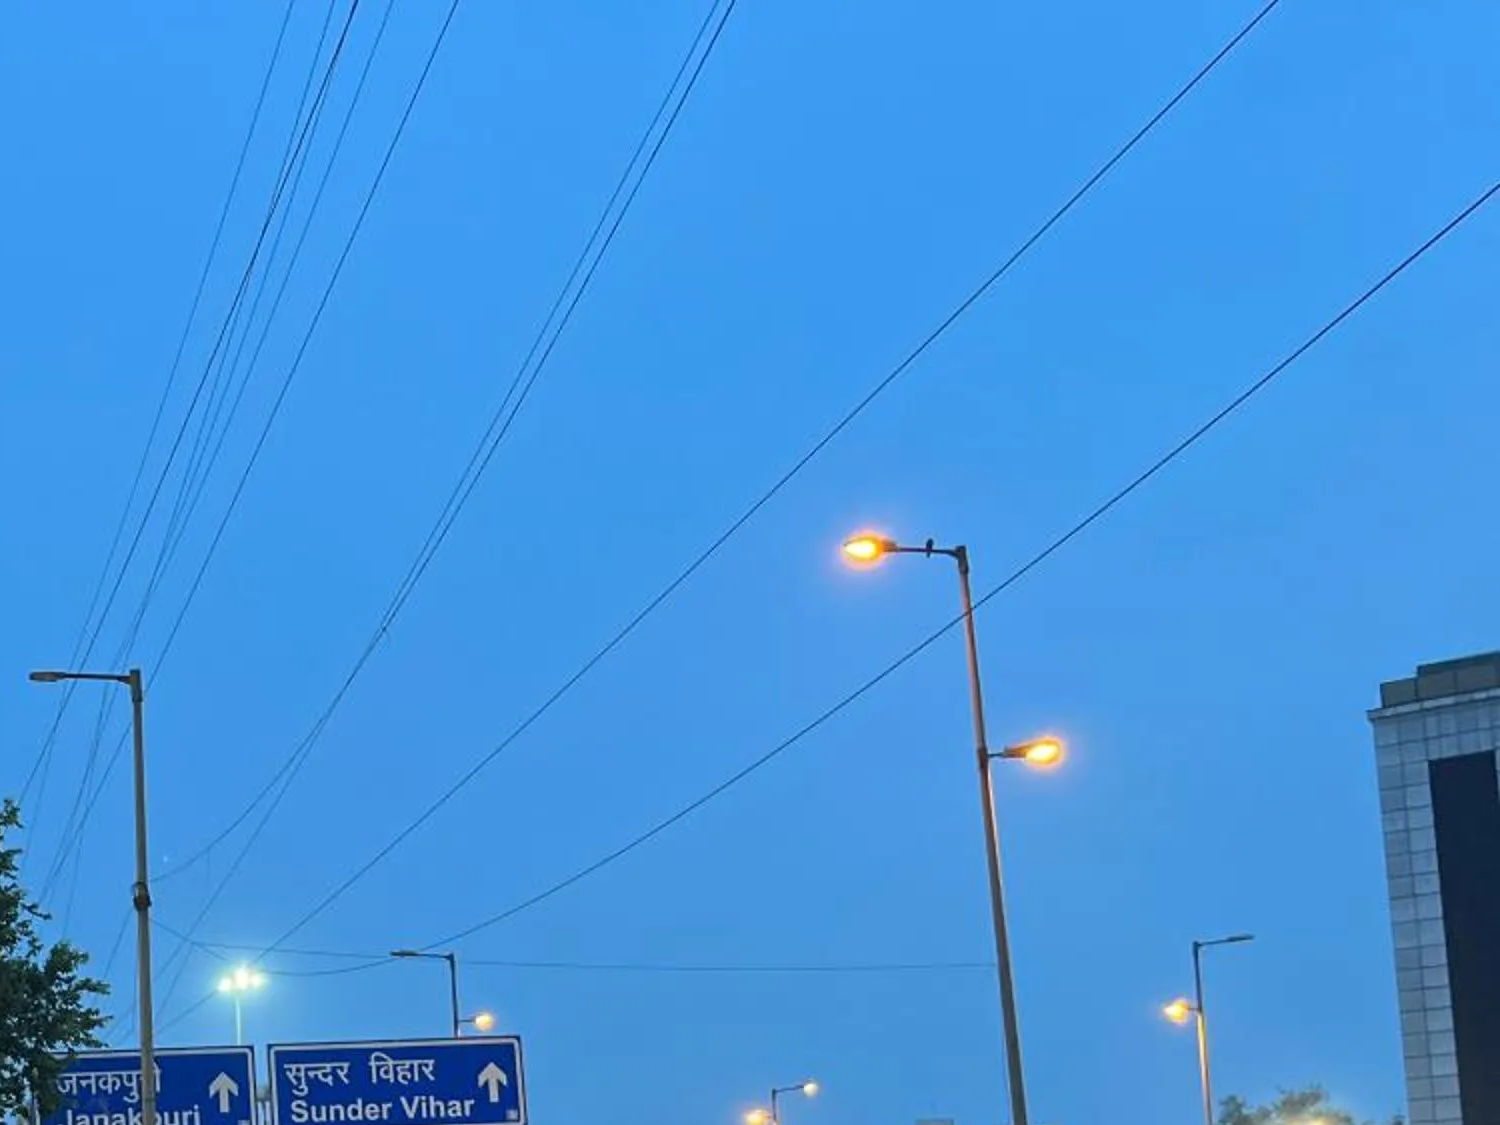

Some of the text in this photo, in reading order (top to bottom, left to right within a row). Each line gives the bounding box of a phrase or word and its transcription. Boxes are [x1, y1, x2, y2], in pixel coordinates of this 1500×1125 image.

[284, 1051, 436, 1097] सुन्दर विहार
[290, 1096, 475, 1123] Sunder Vihar
